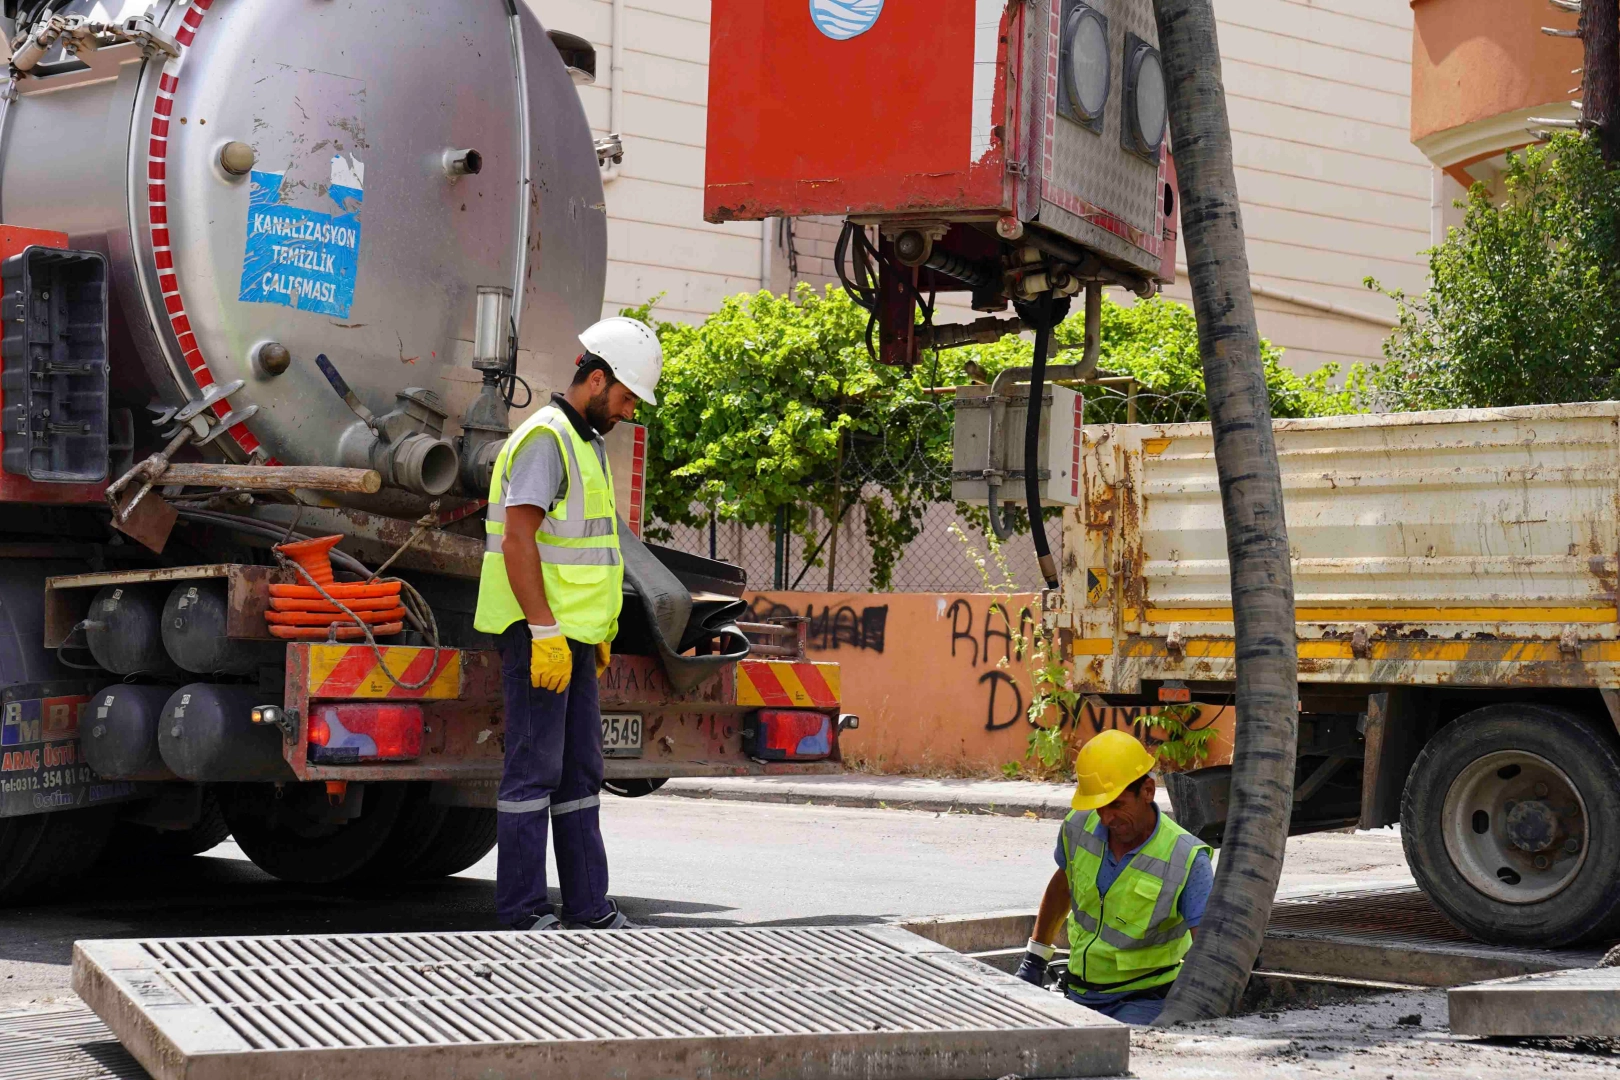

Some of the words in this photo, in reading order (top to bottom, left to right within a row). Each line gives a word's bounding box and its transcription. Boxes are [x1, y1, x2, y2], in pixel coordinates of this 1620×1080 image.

[253, 212, 356, 249] KANALİZASYON
[272, 245, 336, 274] TEMİZLİK
[262, 271, 336, 303] ÇALIŞMASI
[601, 718, 640, 746] 2549
[1, 749, 40, 773] ARAÇ
[43, 740, 75, 767] ÜSTÜ
[42, 770, 62, 788] 354
[65, 767, 76, 784] 81
